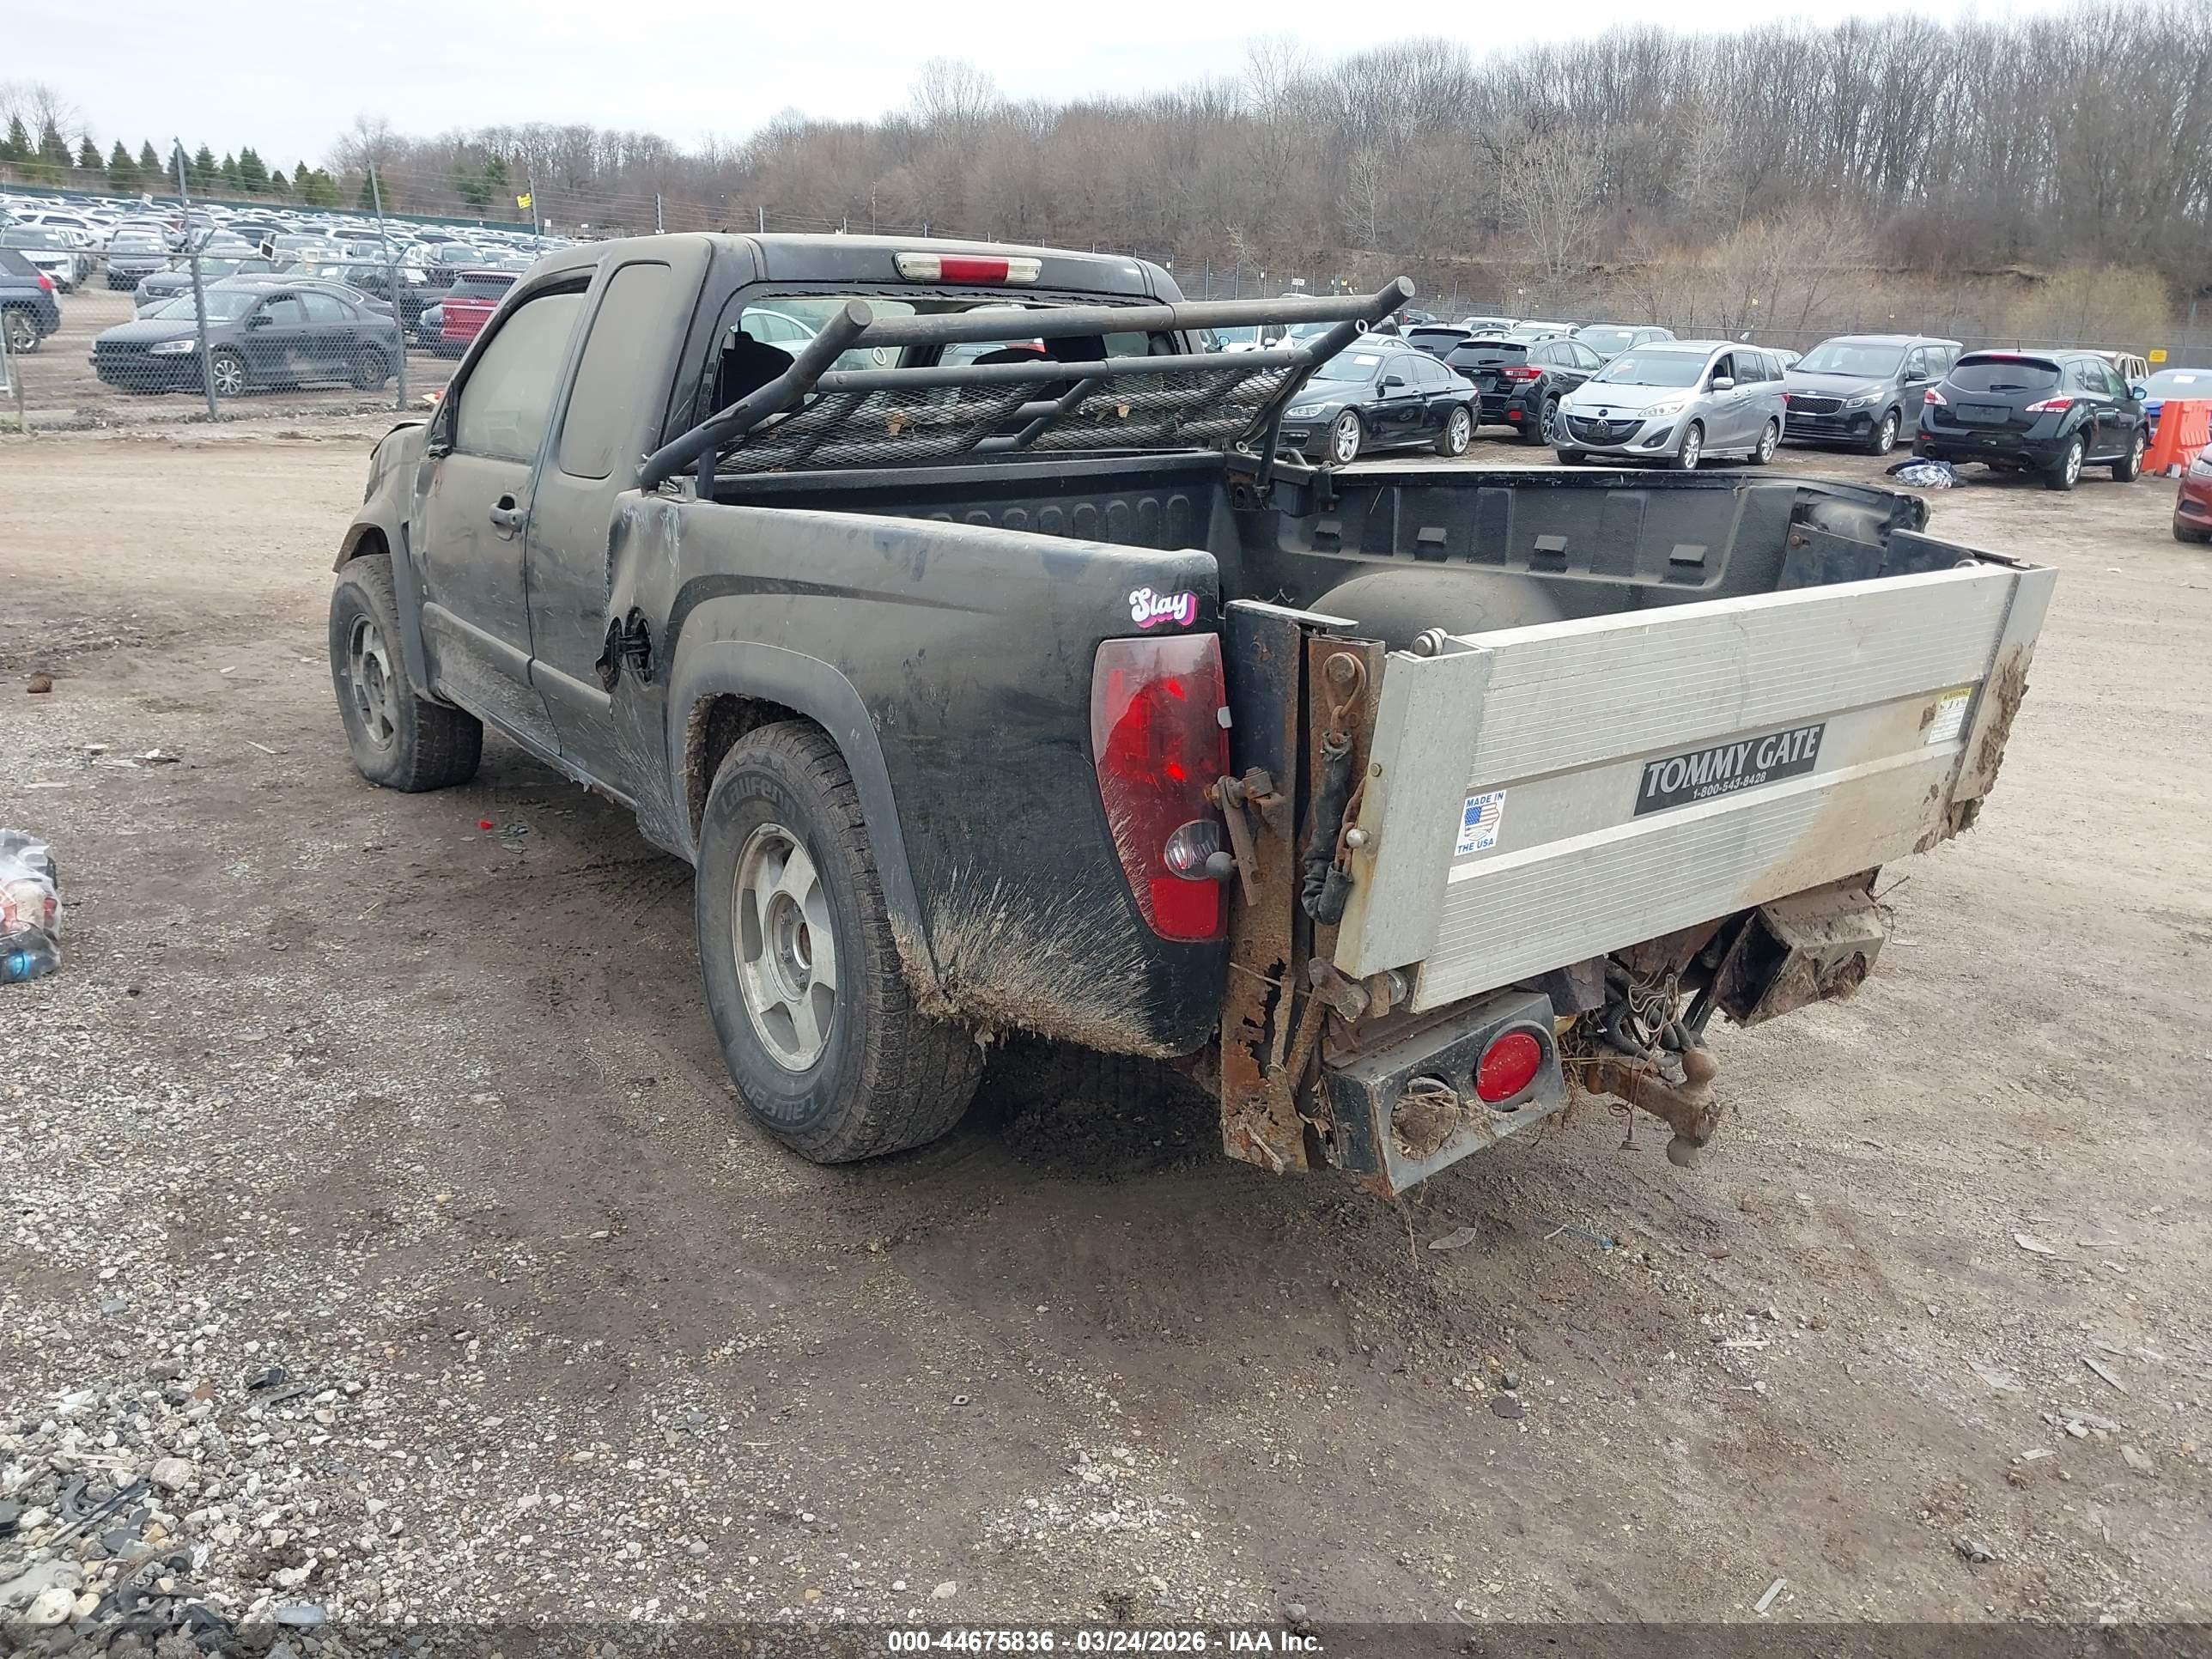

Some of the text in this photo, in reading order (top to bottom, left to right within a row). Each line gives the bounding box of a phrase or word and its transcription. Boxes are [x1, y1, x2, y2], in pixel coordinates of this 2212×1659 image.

[1129, 587, 1190, 623] Slay
[1646, 726, 1820, 798] TOMMY GATE
[1692, 771, 1767, 799] 1-800-543-8428
[1467, 792, 1504, 808] MADE IN
[1457, 838, 1494, 854] THE USA
